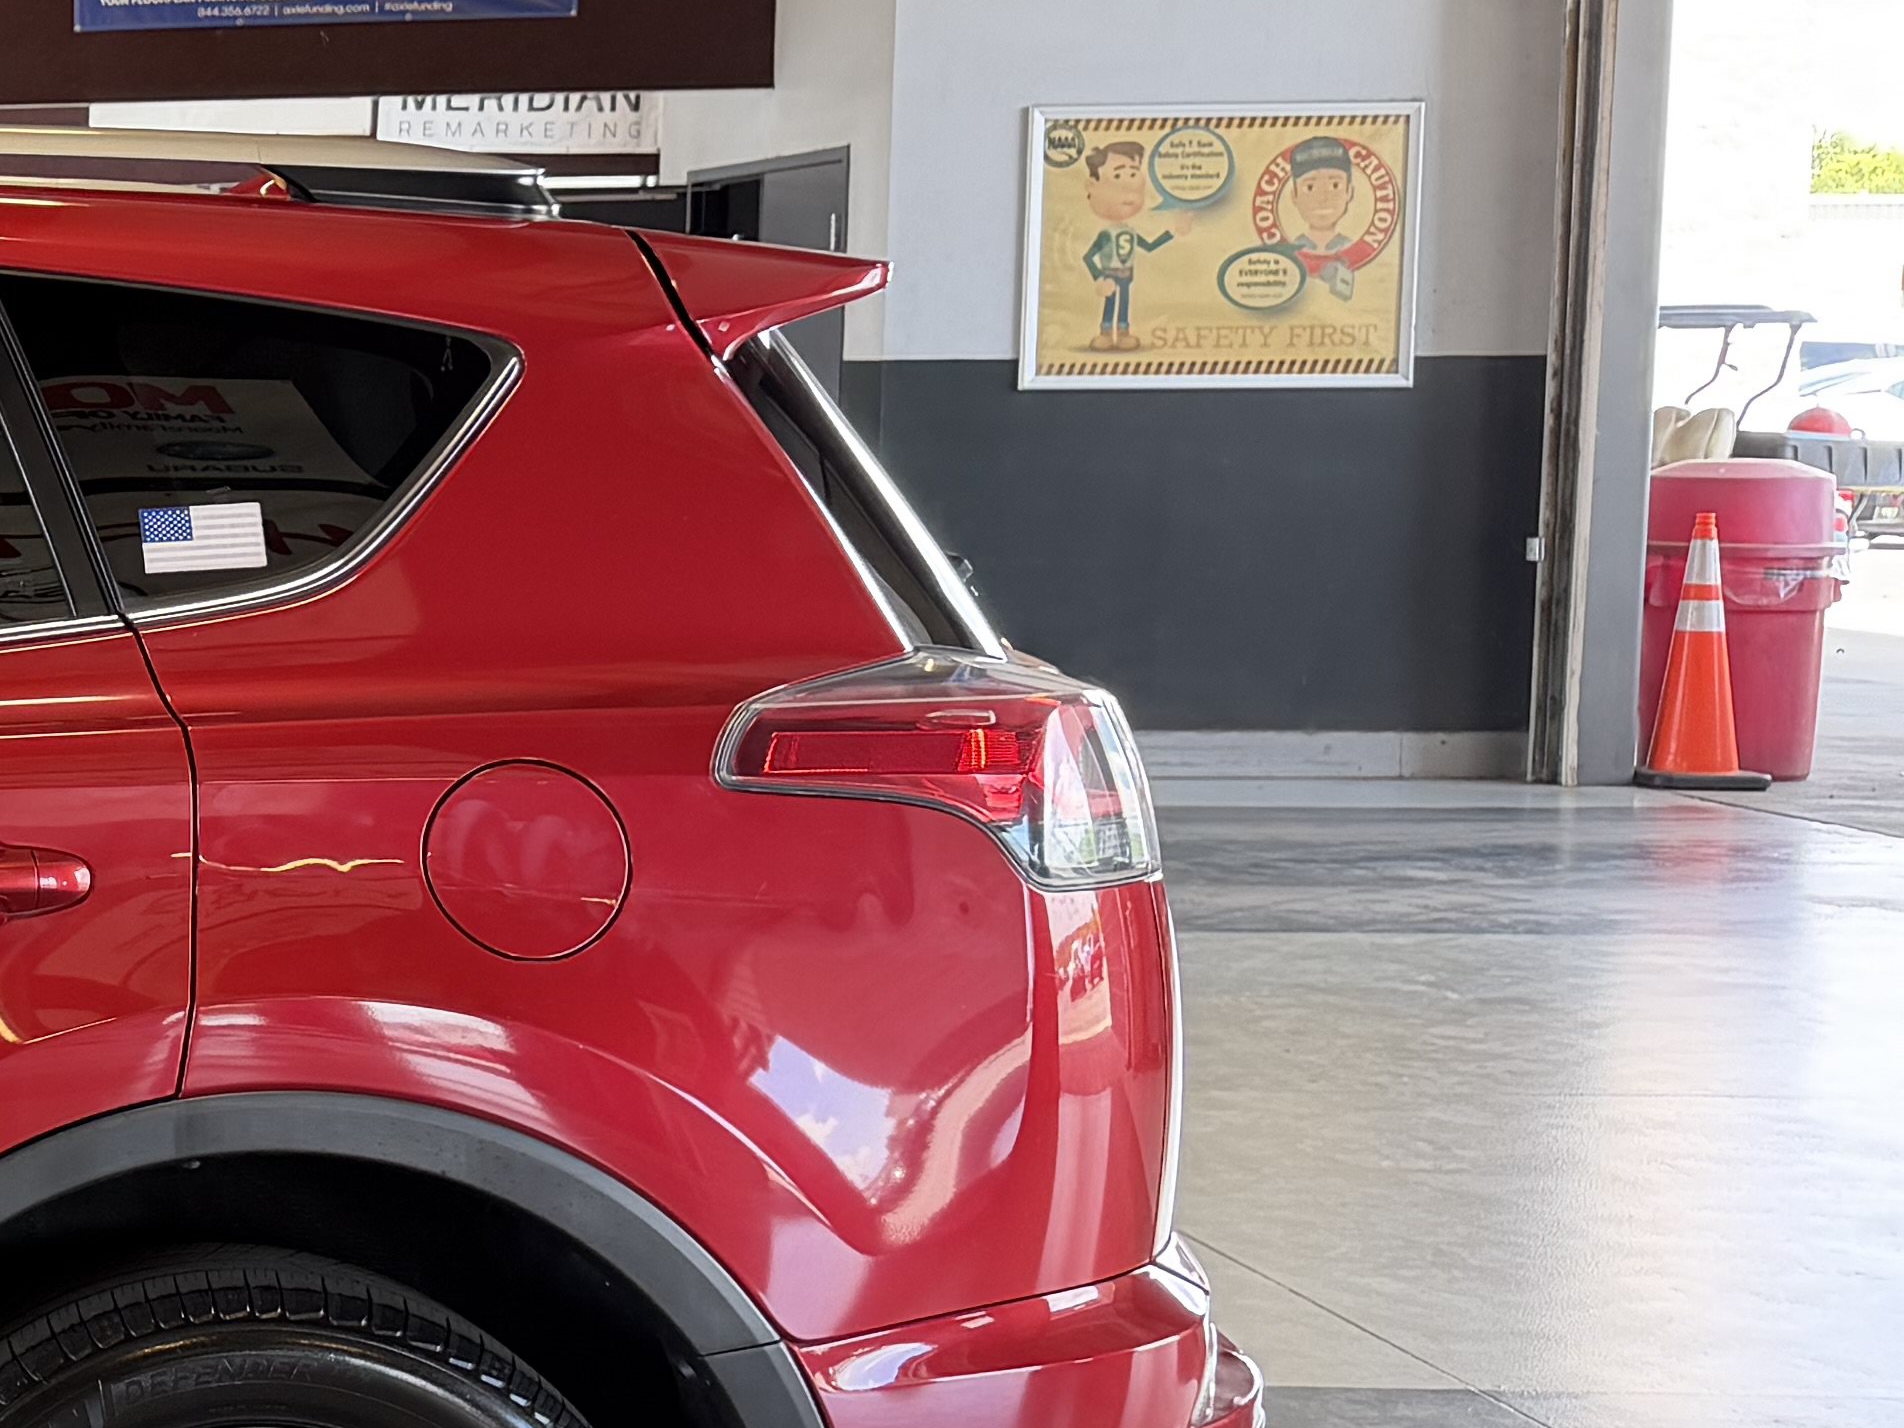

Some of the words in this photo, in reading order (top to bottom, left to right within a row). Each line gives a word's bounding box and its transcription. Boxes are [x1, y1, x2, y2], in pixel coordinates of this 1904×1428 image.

[398, 120, 642, 139] REMARKETING
[1254, 156, 1292, 245] COACH
[1348, 145, 1394, 250] CAUTION
[1150, 327, 1275, 350] SAFETY
[1287, 324, 1378, 349] FIRST
